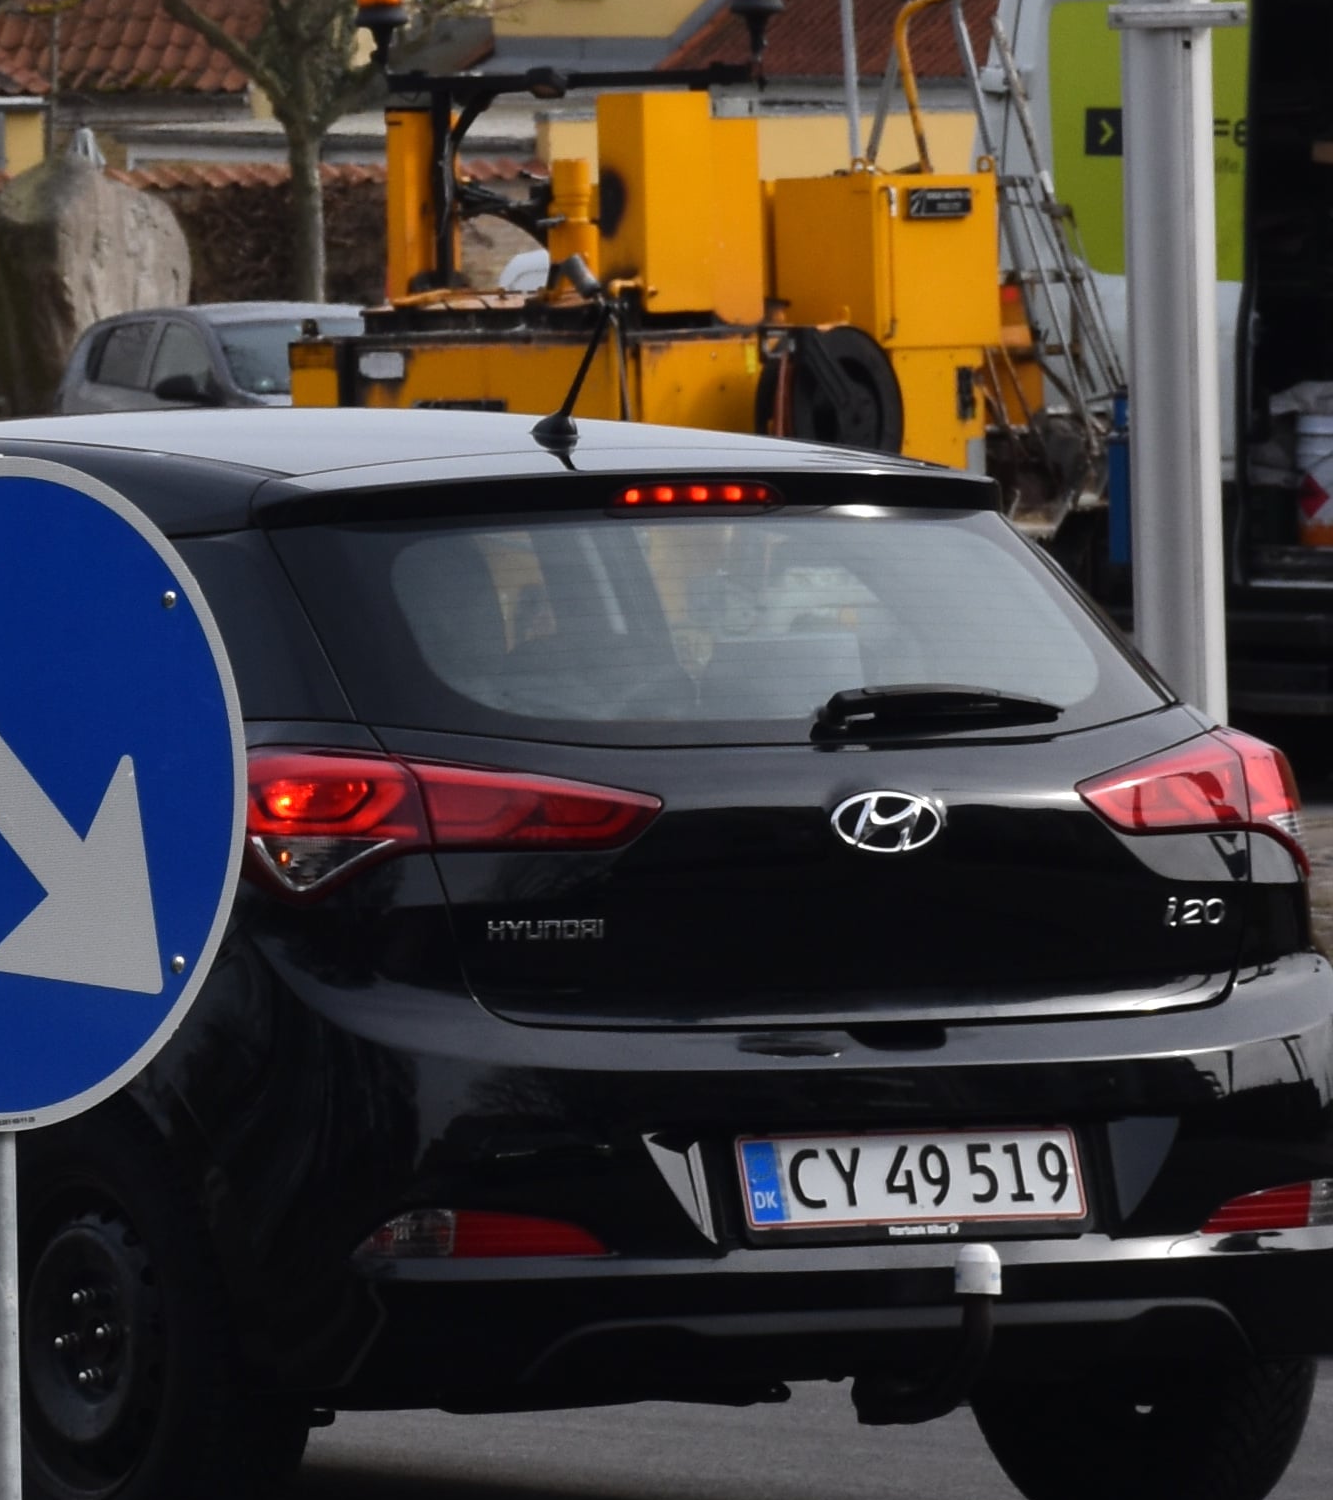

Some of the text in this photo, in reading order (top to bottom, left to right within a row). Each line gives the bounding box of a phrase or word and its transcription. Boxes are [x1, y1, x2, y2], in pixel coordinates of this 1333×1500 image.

[1164, 896, 1225, 926] i20
[487, 919, 604, 940] HYUNDAI
[789, 1141, 1070, 1210] CY 49 519
[754, 1192, 779, 1210] DK
